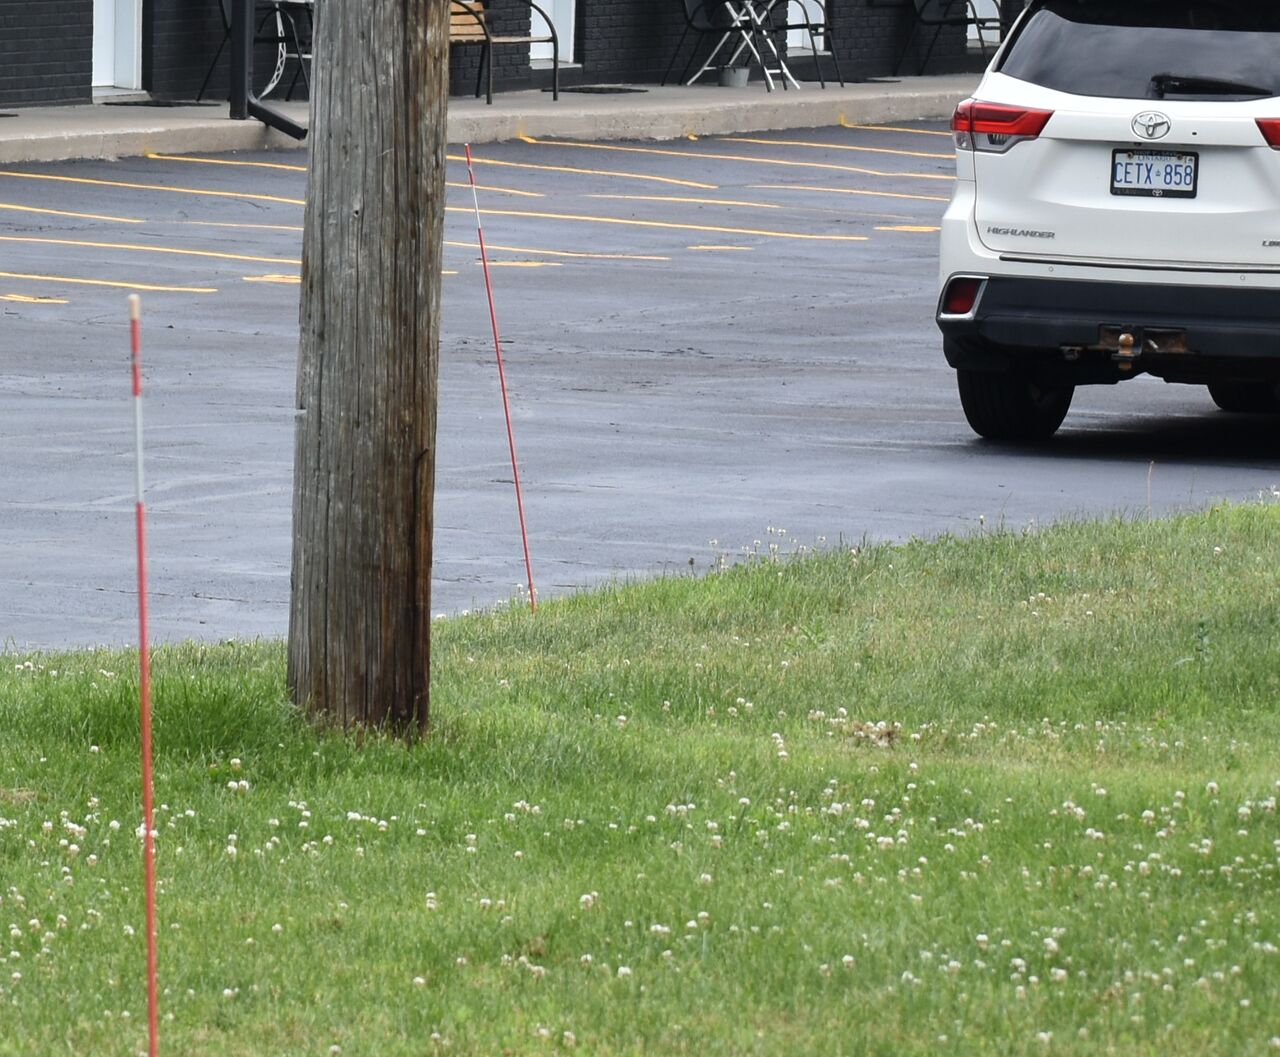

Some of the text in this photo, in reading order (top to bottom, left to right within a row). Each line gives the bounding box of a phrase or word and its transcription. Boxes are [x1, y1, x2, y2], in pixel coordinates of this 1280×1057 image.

[1114, 162, 1193, 186] CETX 858
[987, 226, 1056, 240] HIGHLANDER
